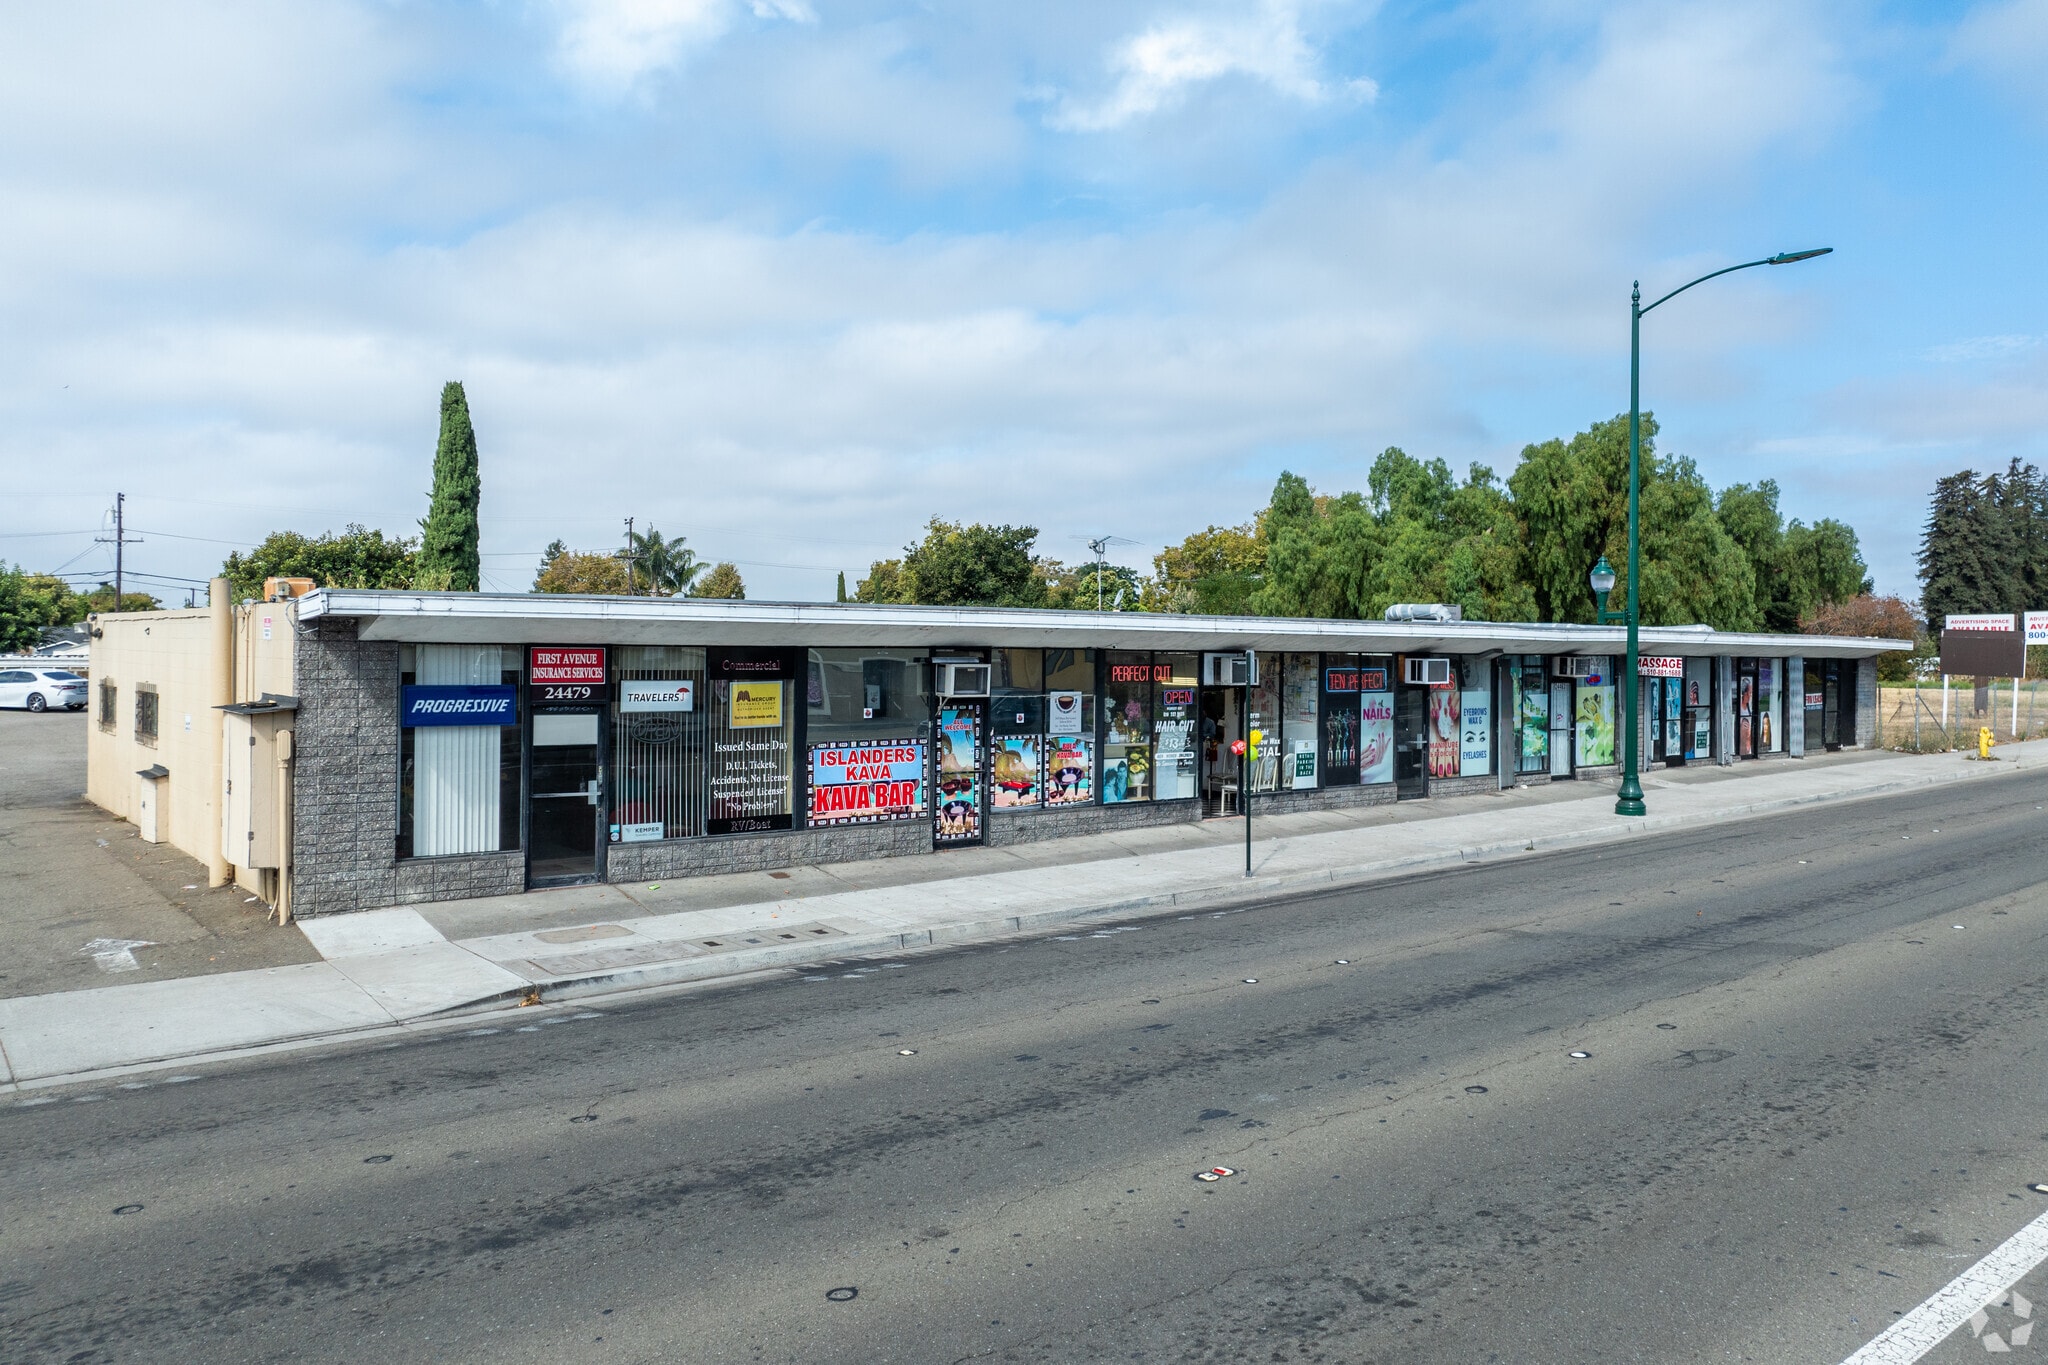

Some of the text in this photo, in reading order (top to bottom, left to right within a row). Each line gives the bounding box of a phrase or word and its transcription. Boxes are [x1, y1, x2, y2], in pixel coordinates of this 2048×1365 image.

[538, 653, 598, 665] FIRST AVENUE
[722, 660, 781, 671] Commercial
[533, 667, 603, 679] INSURANCE SERVICES
[1112, 665, 1172, 682] PERFECT CUT
[1329, 673, 1383, 690] TEN PERFECT
[545, 687, 592, 699] 24479
[627, 693, 680, 702] TRAVELERS
[1166, 691, 1193, 704] OPEN
[412, 699, 510, 713] PROGRESSIVE
[1463, 707, 1487, 716] EYEBROWS
[1363, 707, 1391, 720] NAILS
[1155, 719, 1195, 733] HAIR CUT
[1468, 716, 1478, 725] WAX
[714, 740, 789, 752] Issued Same Day
[1429, 741, 1459, 749] MANICURE
[820, 748, 916, 767] ISLANDERS
[1258, 746, 1281, 757] CIAL
[1463, 750, 1487, 760] EYELASHES
[749, 760, 777, 769] Tickets,
[846, 765, 891, 781] KAVA
[710, 775, 749, 785] Accidents,
[750, 775, 761, 783] No
[713, 786, 787, 801] Suspended License?
[816, 782, 915, 813] KAVA BAR
[730, 820, 771, 831] RV/Boat
